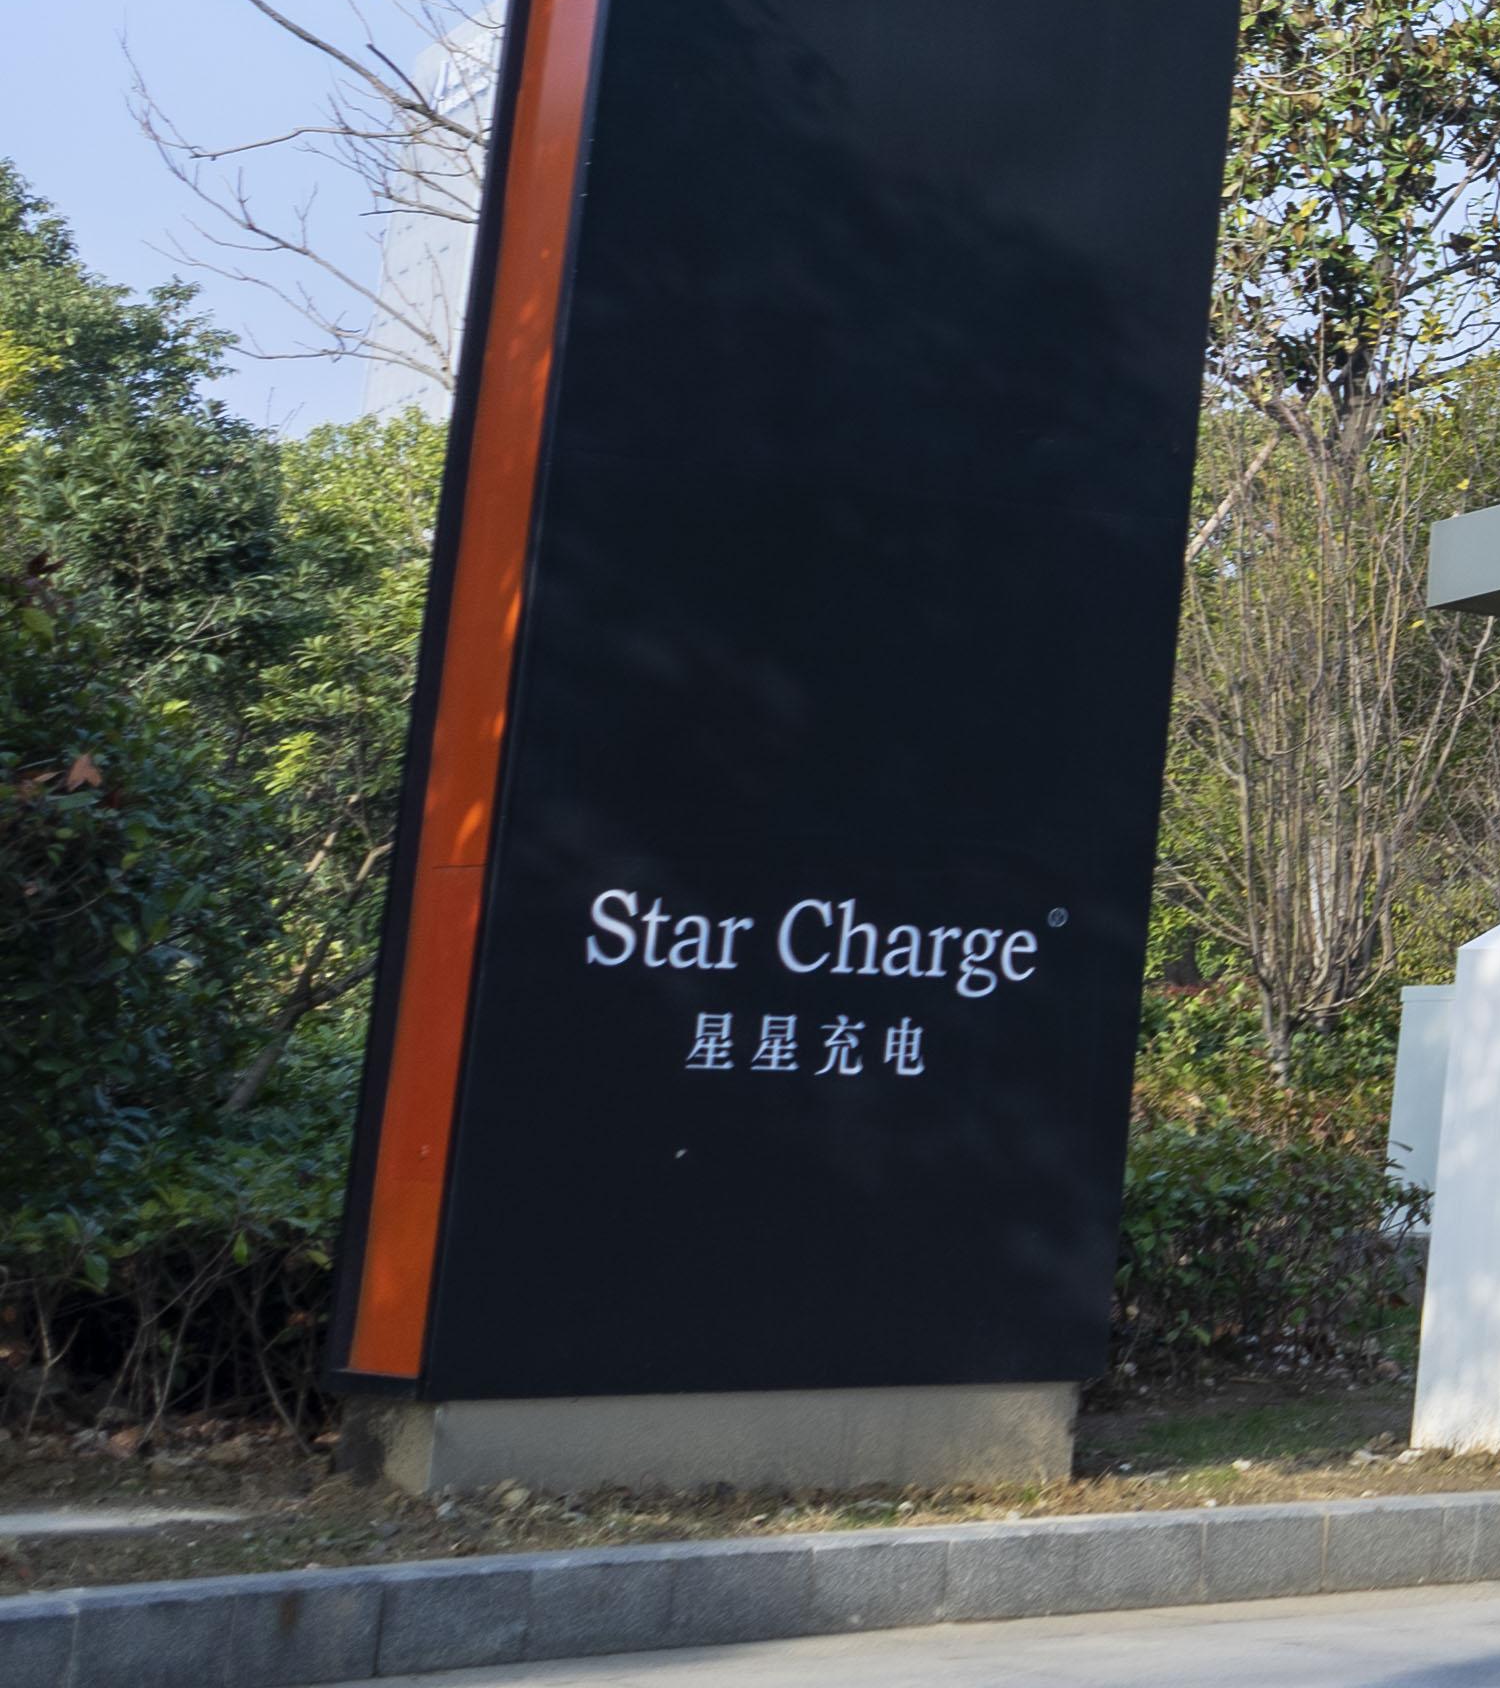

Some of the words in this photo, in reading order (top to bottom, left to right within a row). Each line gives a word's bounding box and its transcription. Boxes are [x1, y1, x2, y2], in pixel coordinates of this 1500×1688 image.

[587, 889, 754, 969] Star
[777, 898, 1038, 998] Charge
[685, 1012, 925, 1076] 星星充电
